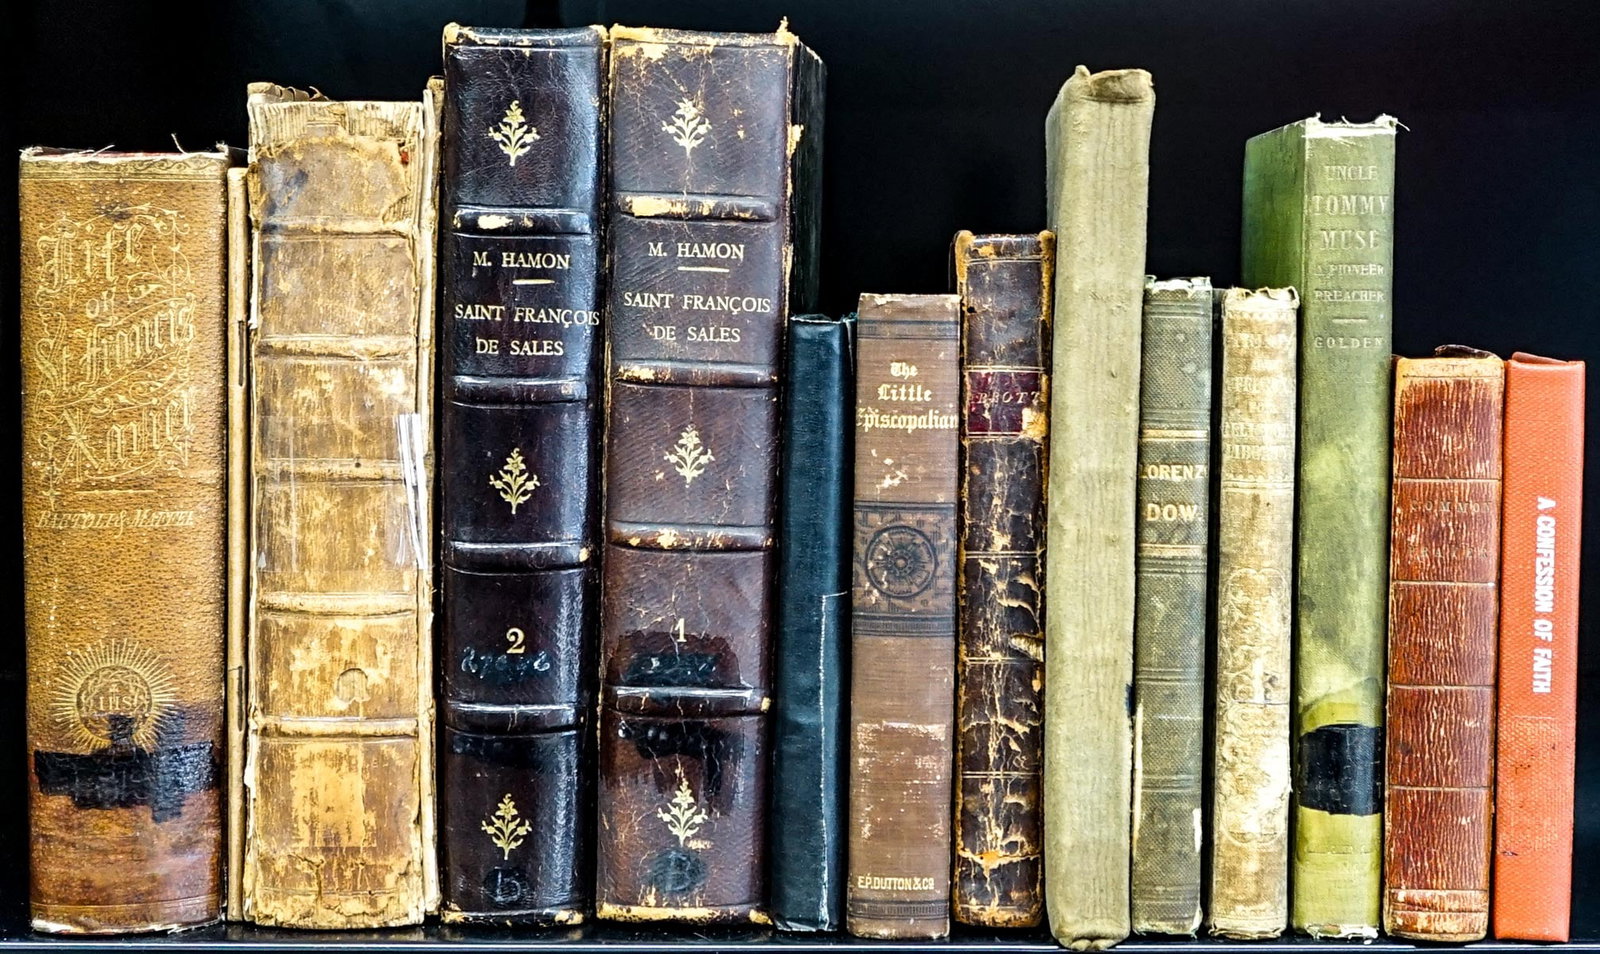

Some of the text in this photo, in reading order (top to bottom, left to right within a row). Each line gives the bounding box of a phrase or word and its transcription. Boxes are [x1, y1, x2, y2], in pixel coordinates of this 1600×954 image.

[1323, 165, 1378, 181] UNCLE
[1311, 194, 1390, 215] TOMMY
[1319, 230, 1380, 250] MUSE
[648, 242, 745, 260] M. HAMON
[473, 252, 570, 269] M. HAMON
[1328, 264, 1385, 276] PIONEER
[624, 292, 771, 315] SAINT FRANÇOIS
[1313, 290, 1385, 302] PREACHER
[454, 304, 600, 328] SAINT FRANÇOIS
[653, 326, 741, 343] DE SALES
[1314, 336, 1384, 349] GOLDEN
[476, 337, 565, 356] DE SALES
[890, 362, 918, 380] The
[877, 384, 932, 402] Little
[1532, 496, 1556, 693] A CONFESSION OF FAITH
[674, 618, 687, 643] 1
[506, 627, 526, 654] 2
